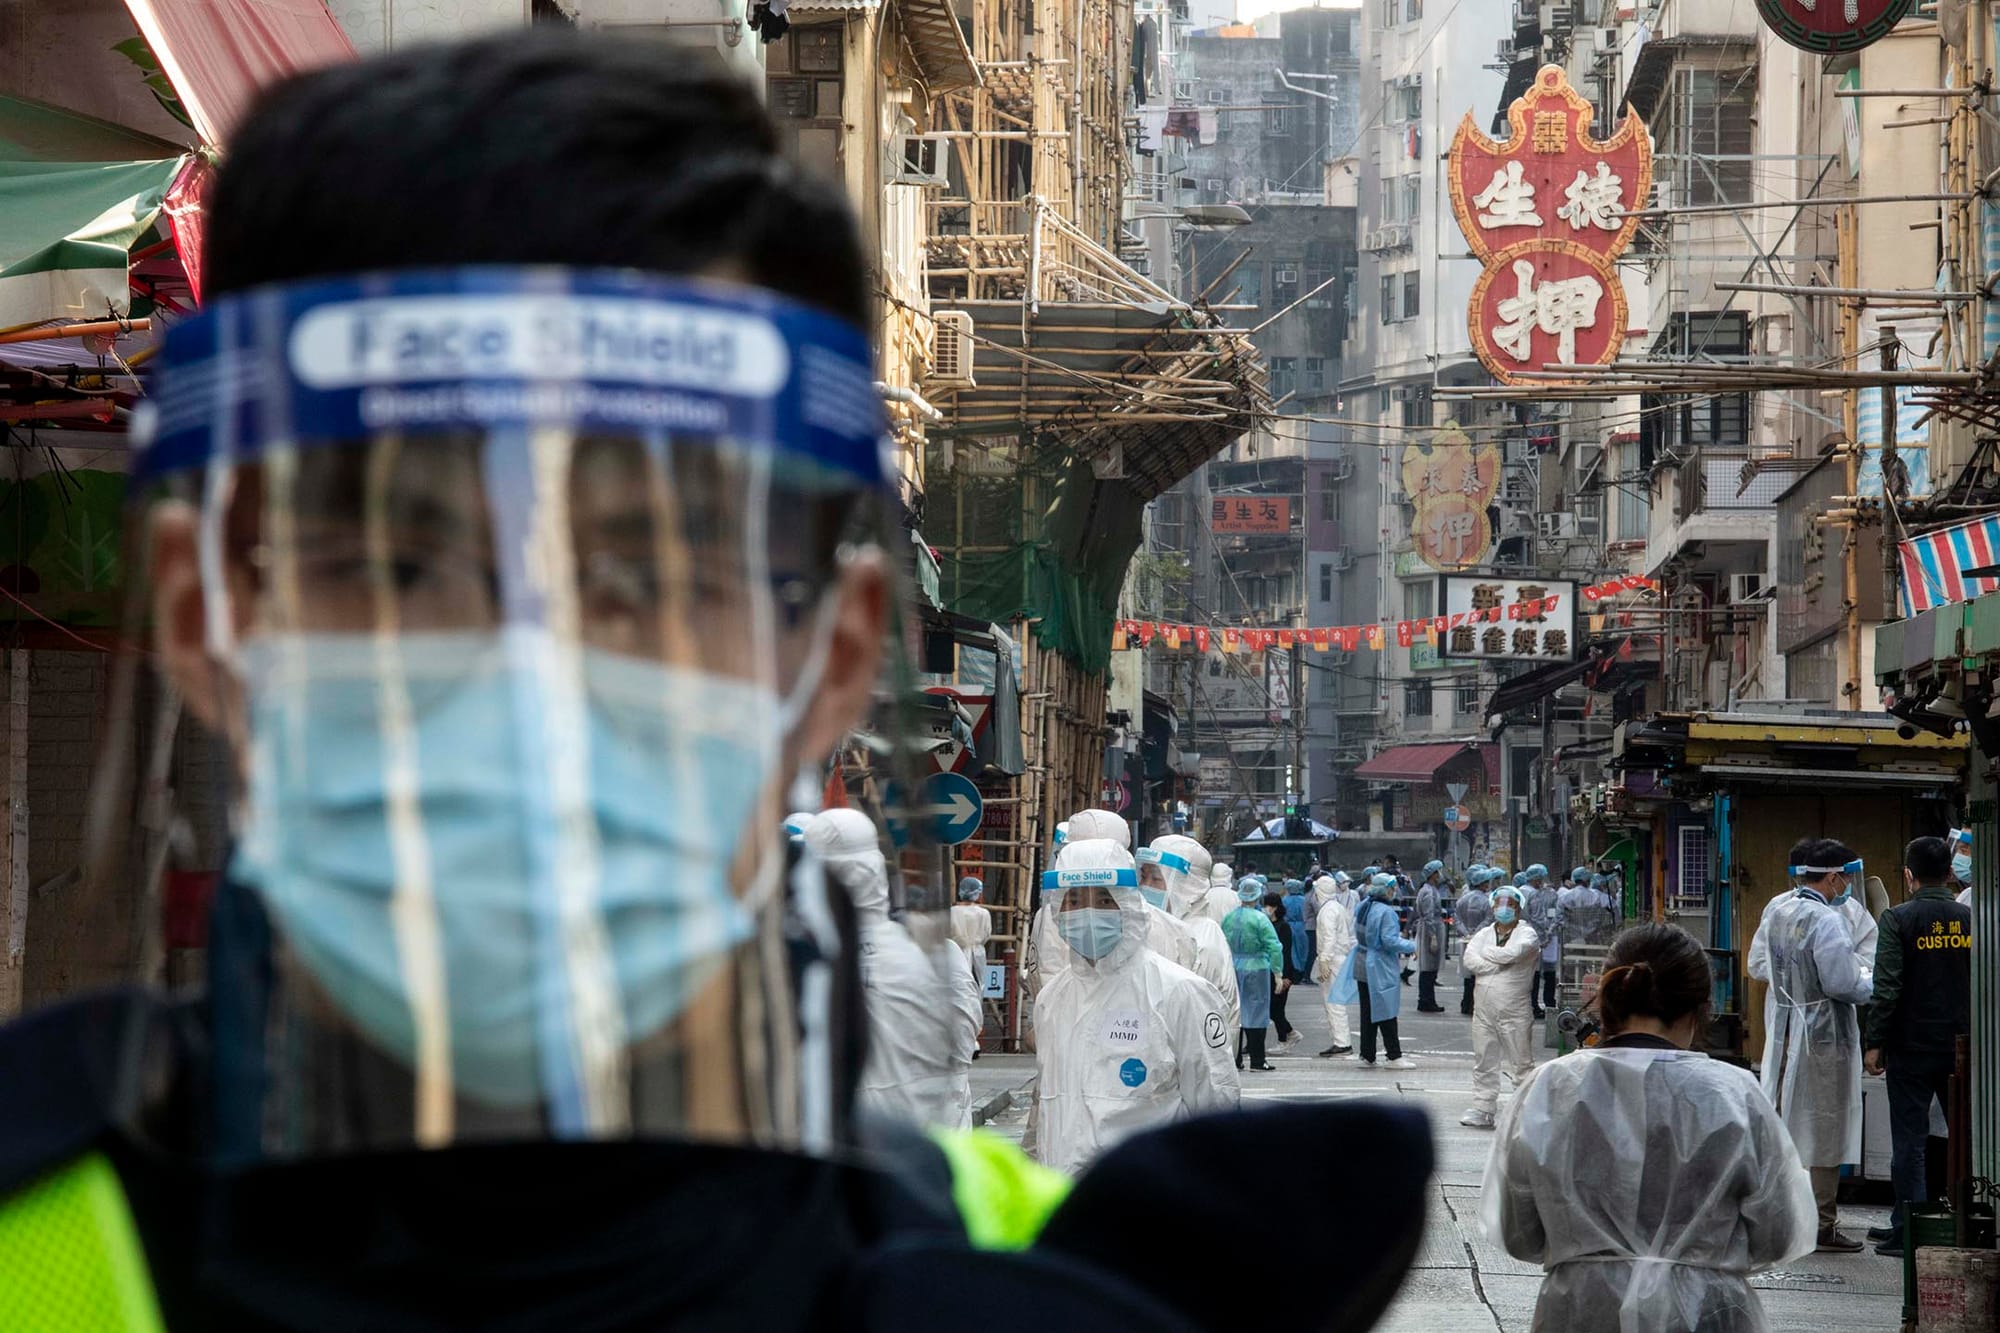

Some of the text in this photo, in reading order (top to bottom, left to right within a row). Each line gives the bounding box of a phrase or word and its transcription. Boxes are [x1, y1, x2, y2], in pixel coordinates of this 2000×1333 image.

[1491, 259, 1603, 365] 押
[1220, 521, 1241, 530] Artist
[1245, 521, 1279, 533] Supplies
[1062, 871, 1112, 881] Face Shield
[1932, 920, 1961, 935] 海關
[990, 970, 998, 987] B
[1110, 1031, 1138, 1041] IMMD
